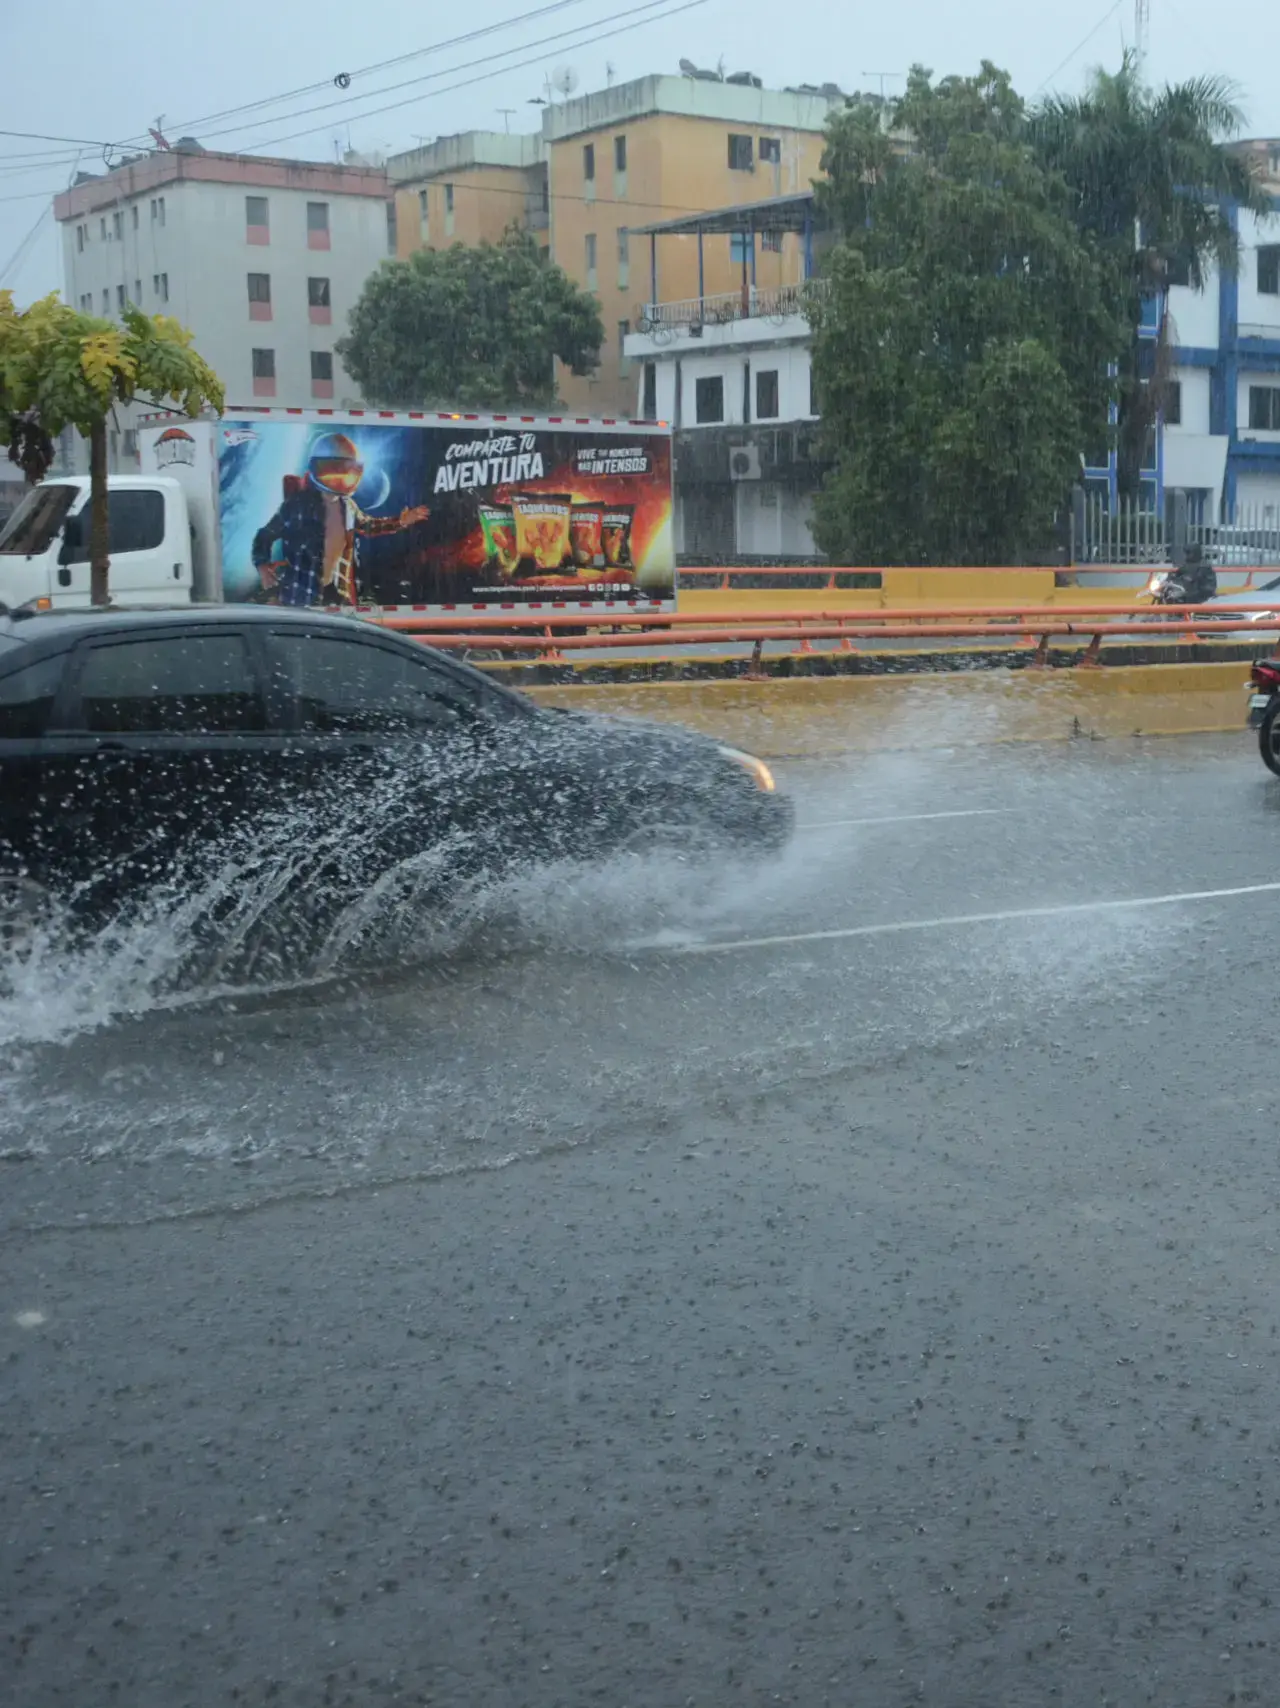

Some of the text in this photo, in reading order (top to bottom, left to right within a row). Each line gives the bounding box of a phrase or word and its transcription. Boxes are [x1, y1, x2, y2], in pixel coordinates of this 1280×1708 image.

[445, 433, 536, 461] COMPARTE TU
[577, 448, 597, 460] VIVE
[433, 452, 544, 494] AVENTURA
[592, 457, 647, 474] INTENSOS
[518, 504, 569, 515] TAQUERITOS
